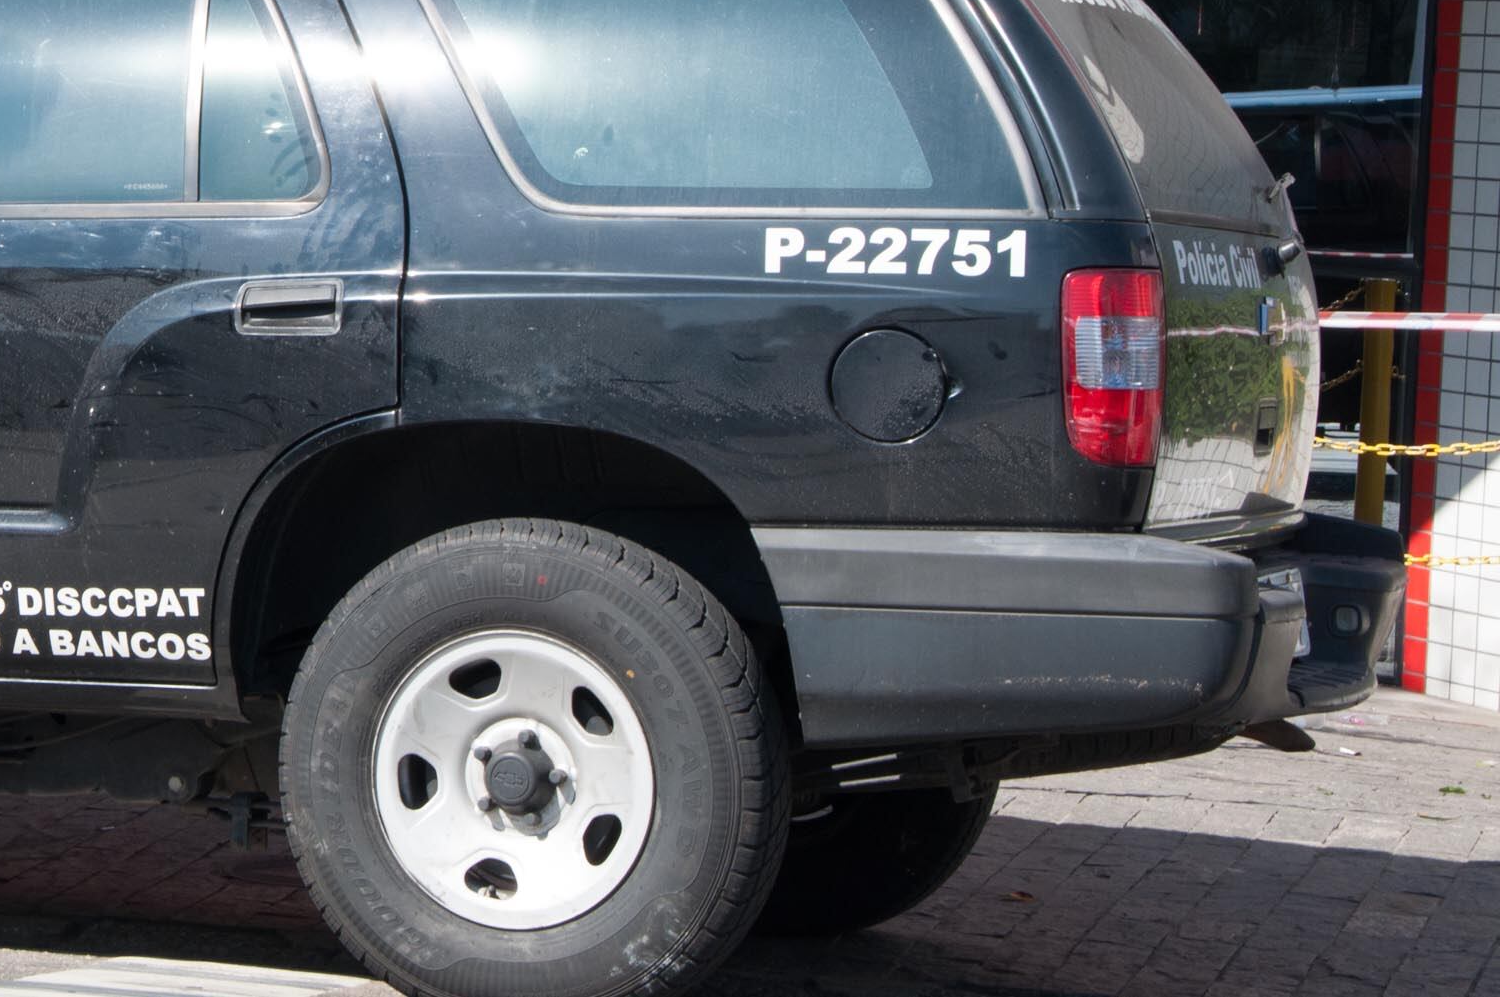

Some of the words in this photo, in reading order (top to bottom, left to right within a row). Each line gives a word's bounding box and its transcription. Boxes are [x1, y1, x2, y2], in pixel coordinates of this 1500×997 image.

[764, 226, 1027, 277] P-22751
[1172, 239, 1231, 287] Polícia
[1229, 243, 1262, 289] Civil
[17, 586, 206, 618] DISCCPAT
[12, 628, 40, 655] A
[48, 629, 212, 661] BANCOS
